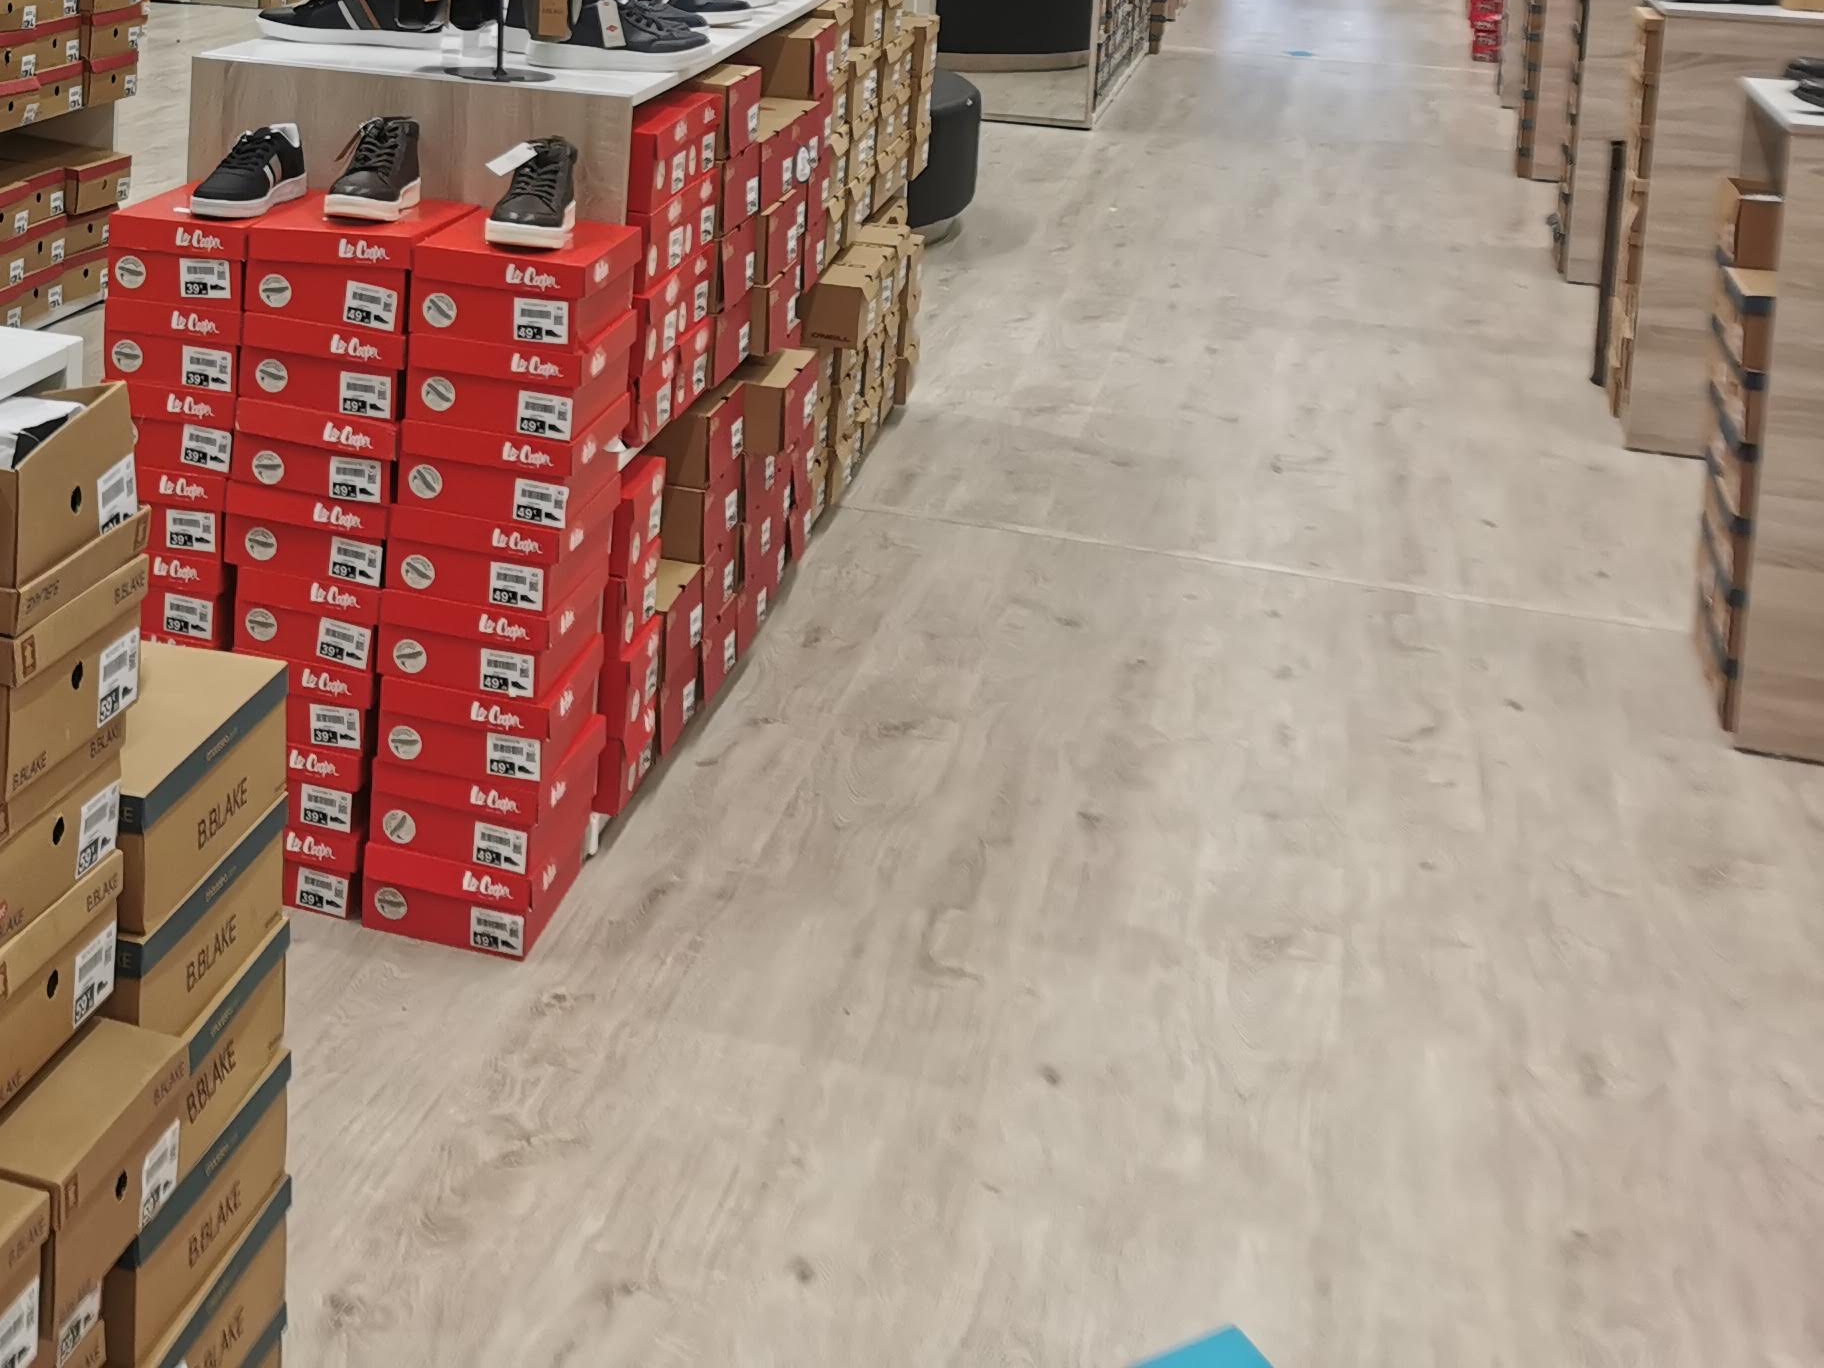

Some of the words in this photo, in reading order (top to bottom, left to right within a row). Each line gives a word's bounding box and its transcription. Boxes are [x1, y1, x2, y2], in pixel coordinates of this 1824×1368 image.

[186, 283, 200, 294] 39
[347, 309, 363, 321] 49
[518, 327, 533, 338] 49
[517, 508, 532, 519] 49
[197, 777, 249, 850] B.BLAKE
[185, 913, 237, 993] B.BLAKE
[185, 1037, 236, 1126] B.BLAKE
